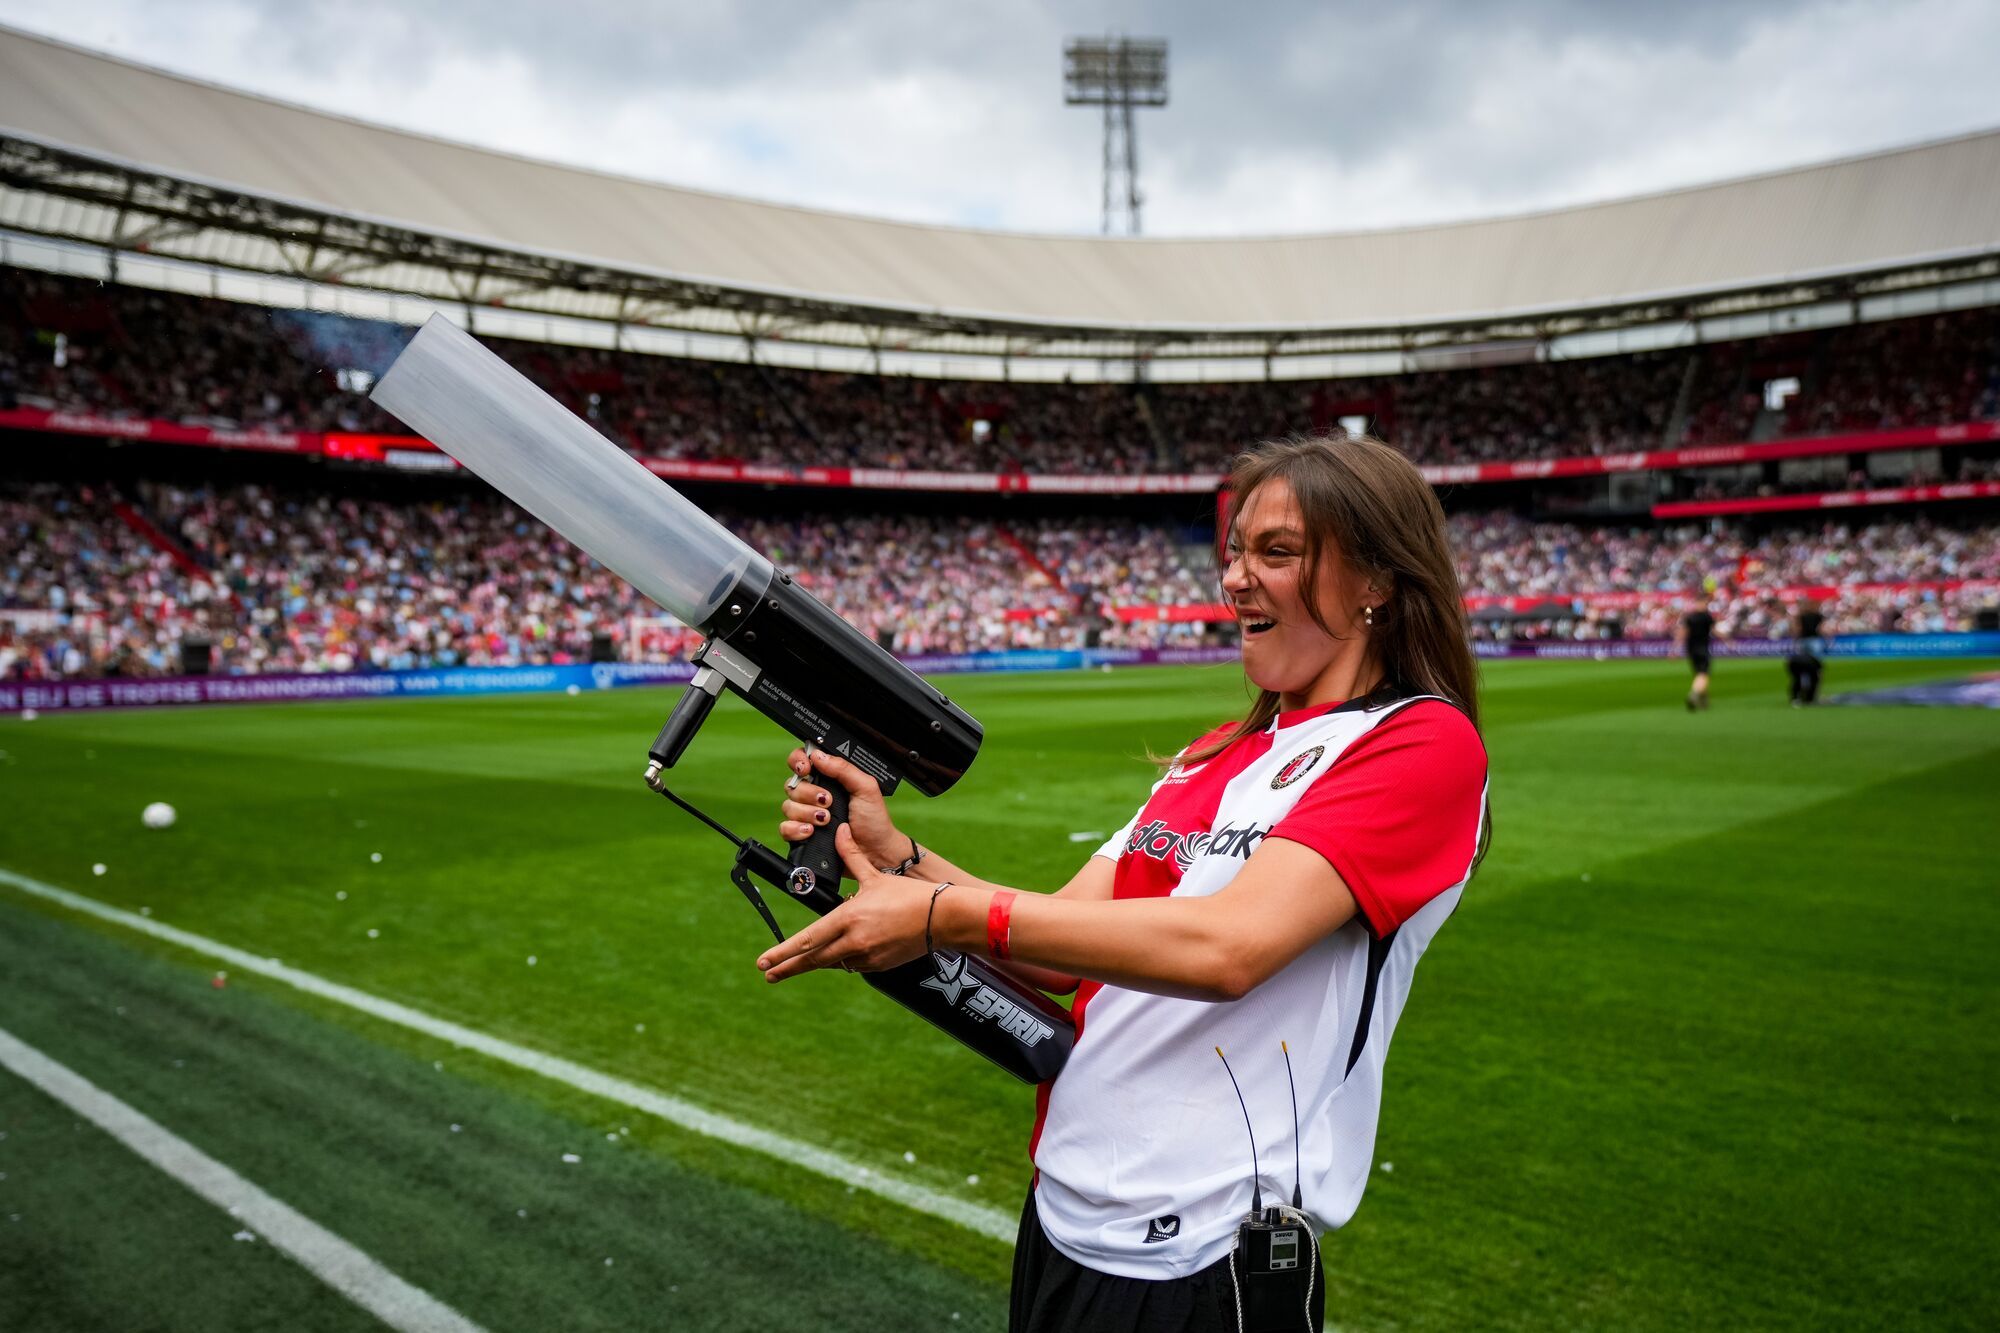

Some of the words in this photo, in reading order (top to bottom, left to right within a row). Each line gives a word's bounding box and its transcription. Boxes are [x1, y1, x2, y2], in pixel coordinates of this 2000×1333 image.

[22, 685, 65, 709] BIJ
[68, 684, 104, 707] DE
[111, 681, 199, 705] TROTSE
[762, 679, 792, 703] BLEACHER
[792, 700, 818, 721] REACHER
[818, 718, 830, 730] PRO
[961, 1006, 984, 1023] FIELD
[966, 984, 1055, 1048] SPIRIT
